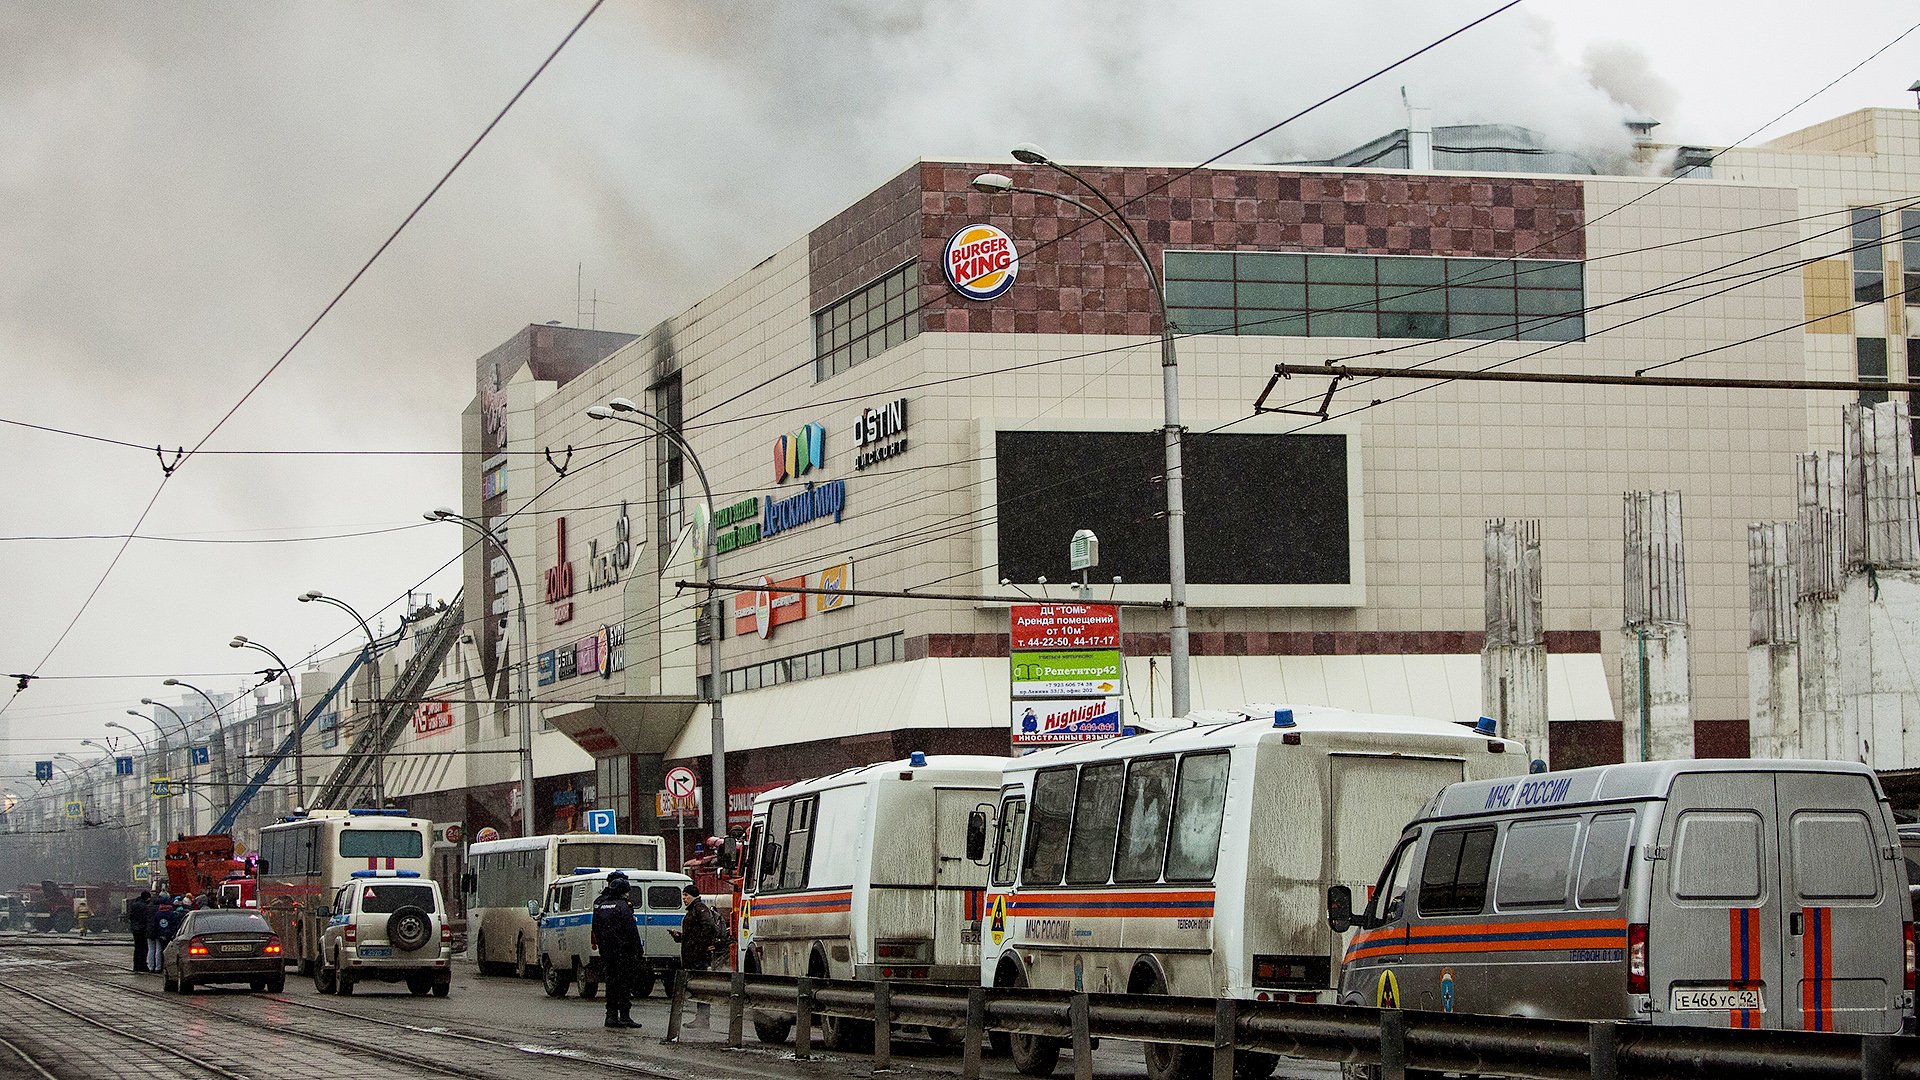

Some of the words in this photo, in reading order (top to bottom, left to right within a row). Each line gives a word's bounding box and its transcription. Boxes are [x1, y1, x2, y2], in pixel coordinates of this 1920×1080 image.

[952, 237, 1008, 265] BURGER
[955, 251, 1011, 284] KING
[763, 481, 815, 537] Детский
[815, 480, 846, 523] мир
[1017, 617, 1054, 626] Аренда
[1056, 615, 1114, 625] помещений
[1040, 607, 1054, 615] ДЦ
[1028, 638, 1071, 647] 44-22-50,
[1073, 636, 1115, 646] 44-17-17
[1044, 666, 1117, 677] Репетитор42
[1044, 700, 1107, 731] Highlight
[1018, 734, 1083, 742] ИНОСТРАННЫЕ
[1485, 784, 1515, 809] МЧС
[1516, 778, 1572, 806] РОССИИ
[594, 813, 610, 834] P
[1025, 919, 1040, 939] МЧС
[1041, 920, 1070, 940] РОССИИ
[1569, 950, 1600, 961] ТЕЛЕФОН
